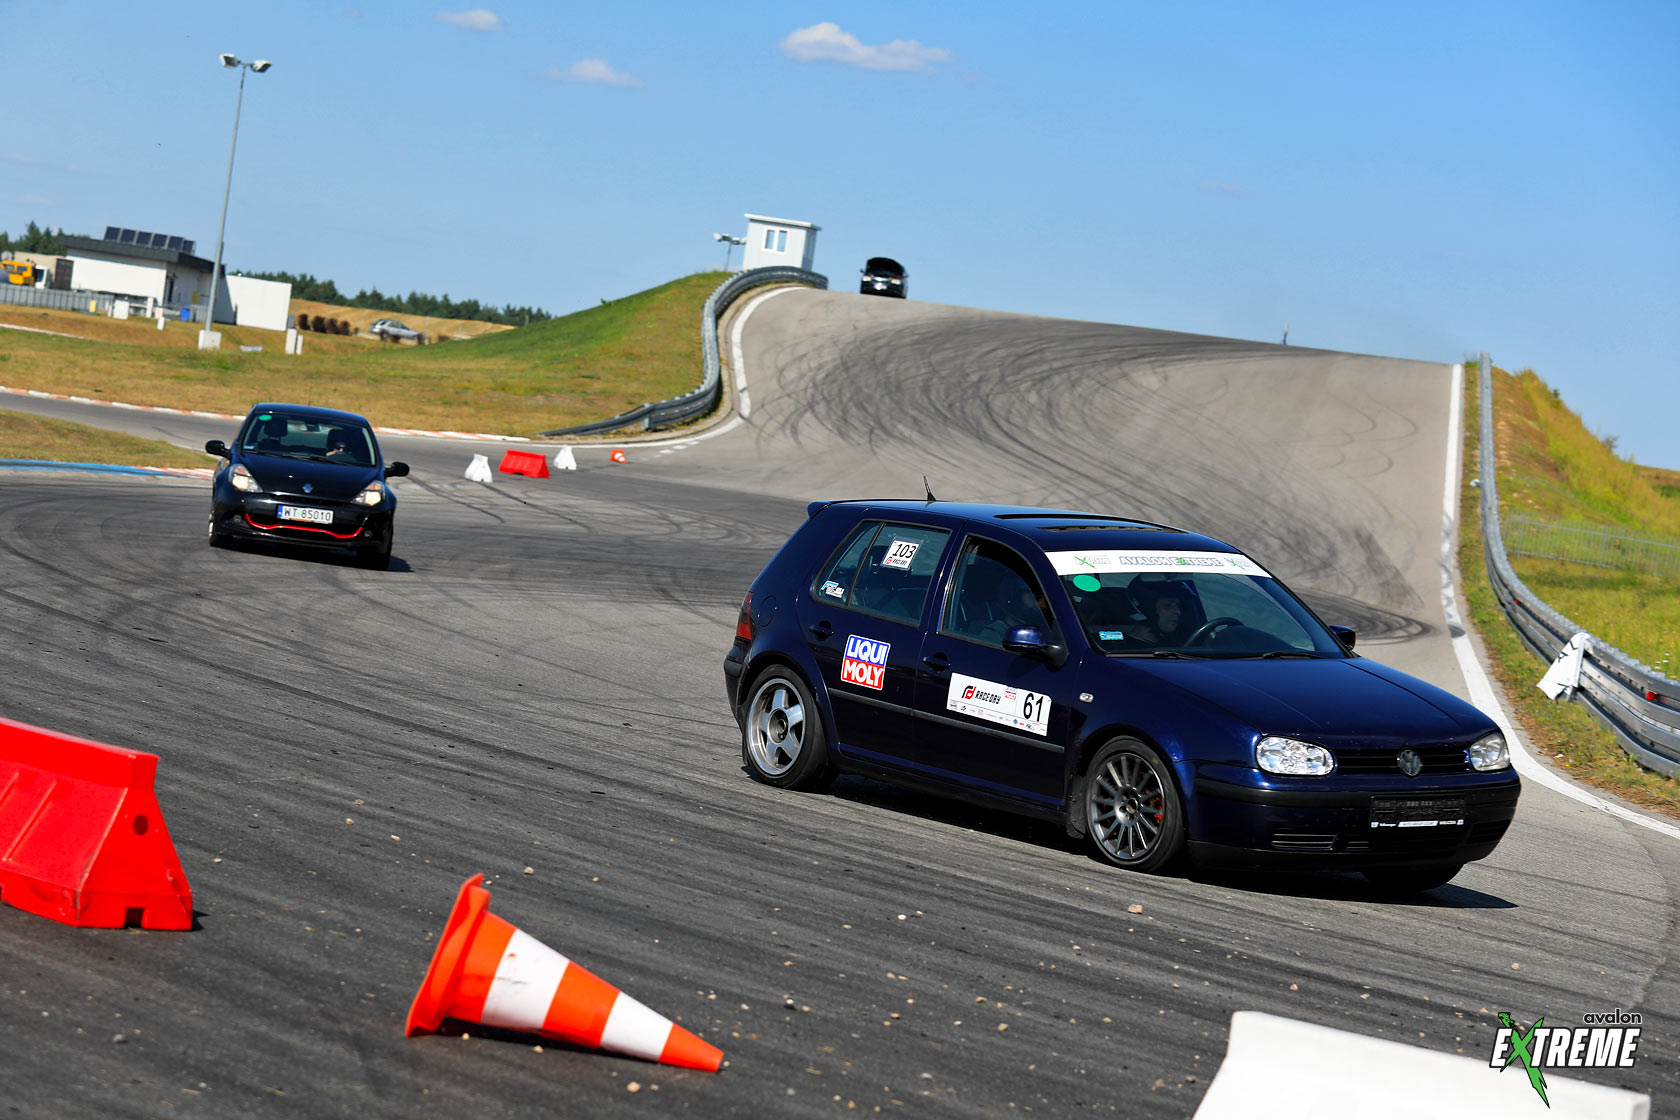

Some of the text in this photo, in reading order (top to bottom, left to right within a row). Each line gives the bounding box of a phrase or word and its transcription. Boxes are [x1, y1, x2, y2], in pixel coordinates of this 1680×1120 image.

[284, 507, 331, 521] WT 85010
[892, 543, 917, 559] 103
[1119, 556, 1171, 565] AVALON
[1170, 556, 1224, 567] EXTREME
[846, 637, 888, 665] LIQUI
[843, 659, 884, 687] MOLY
[1023, 692, 1044, 722] 61
